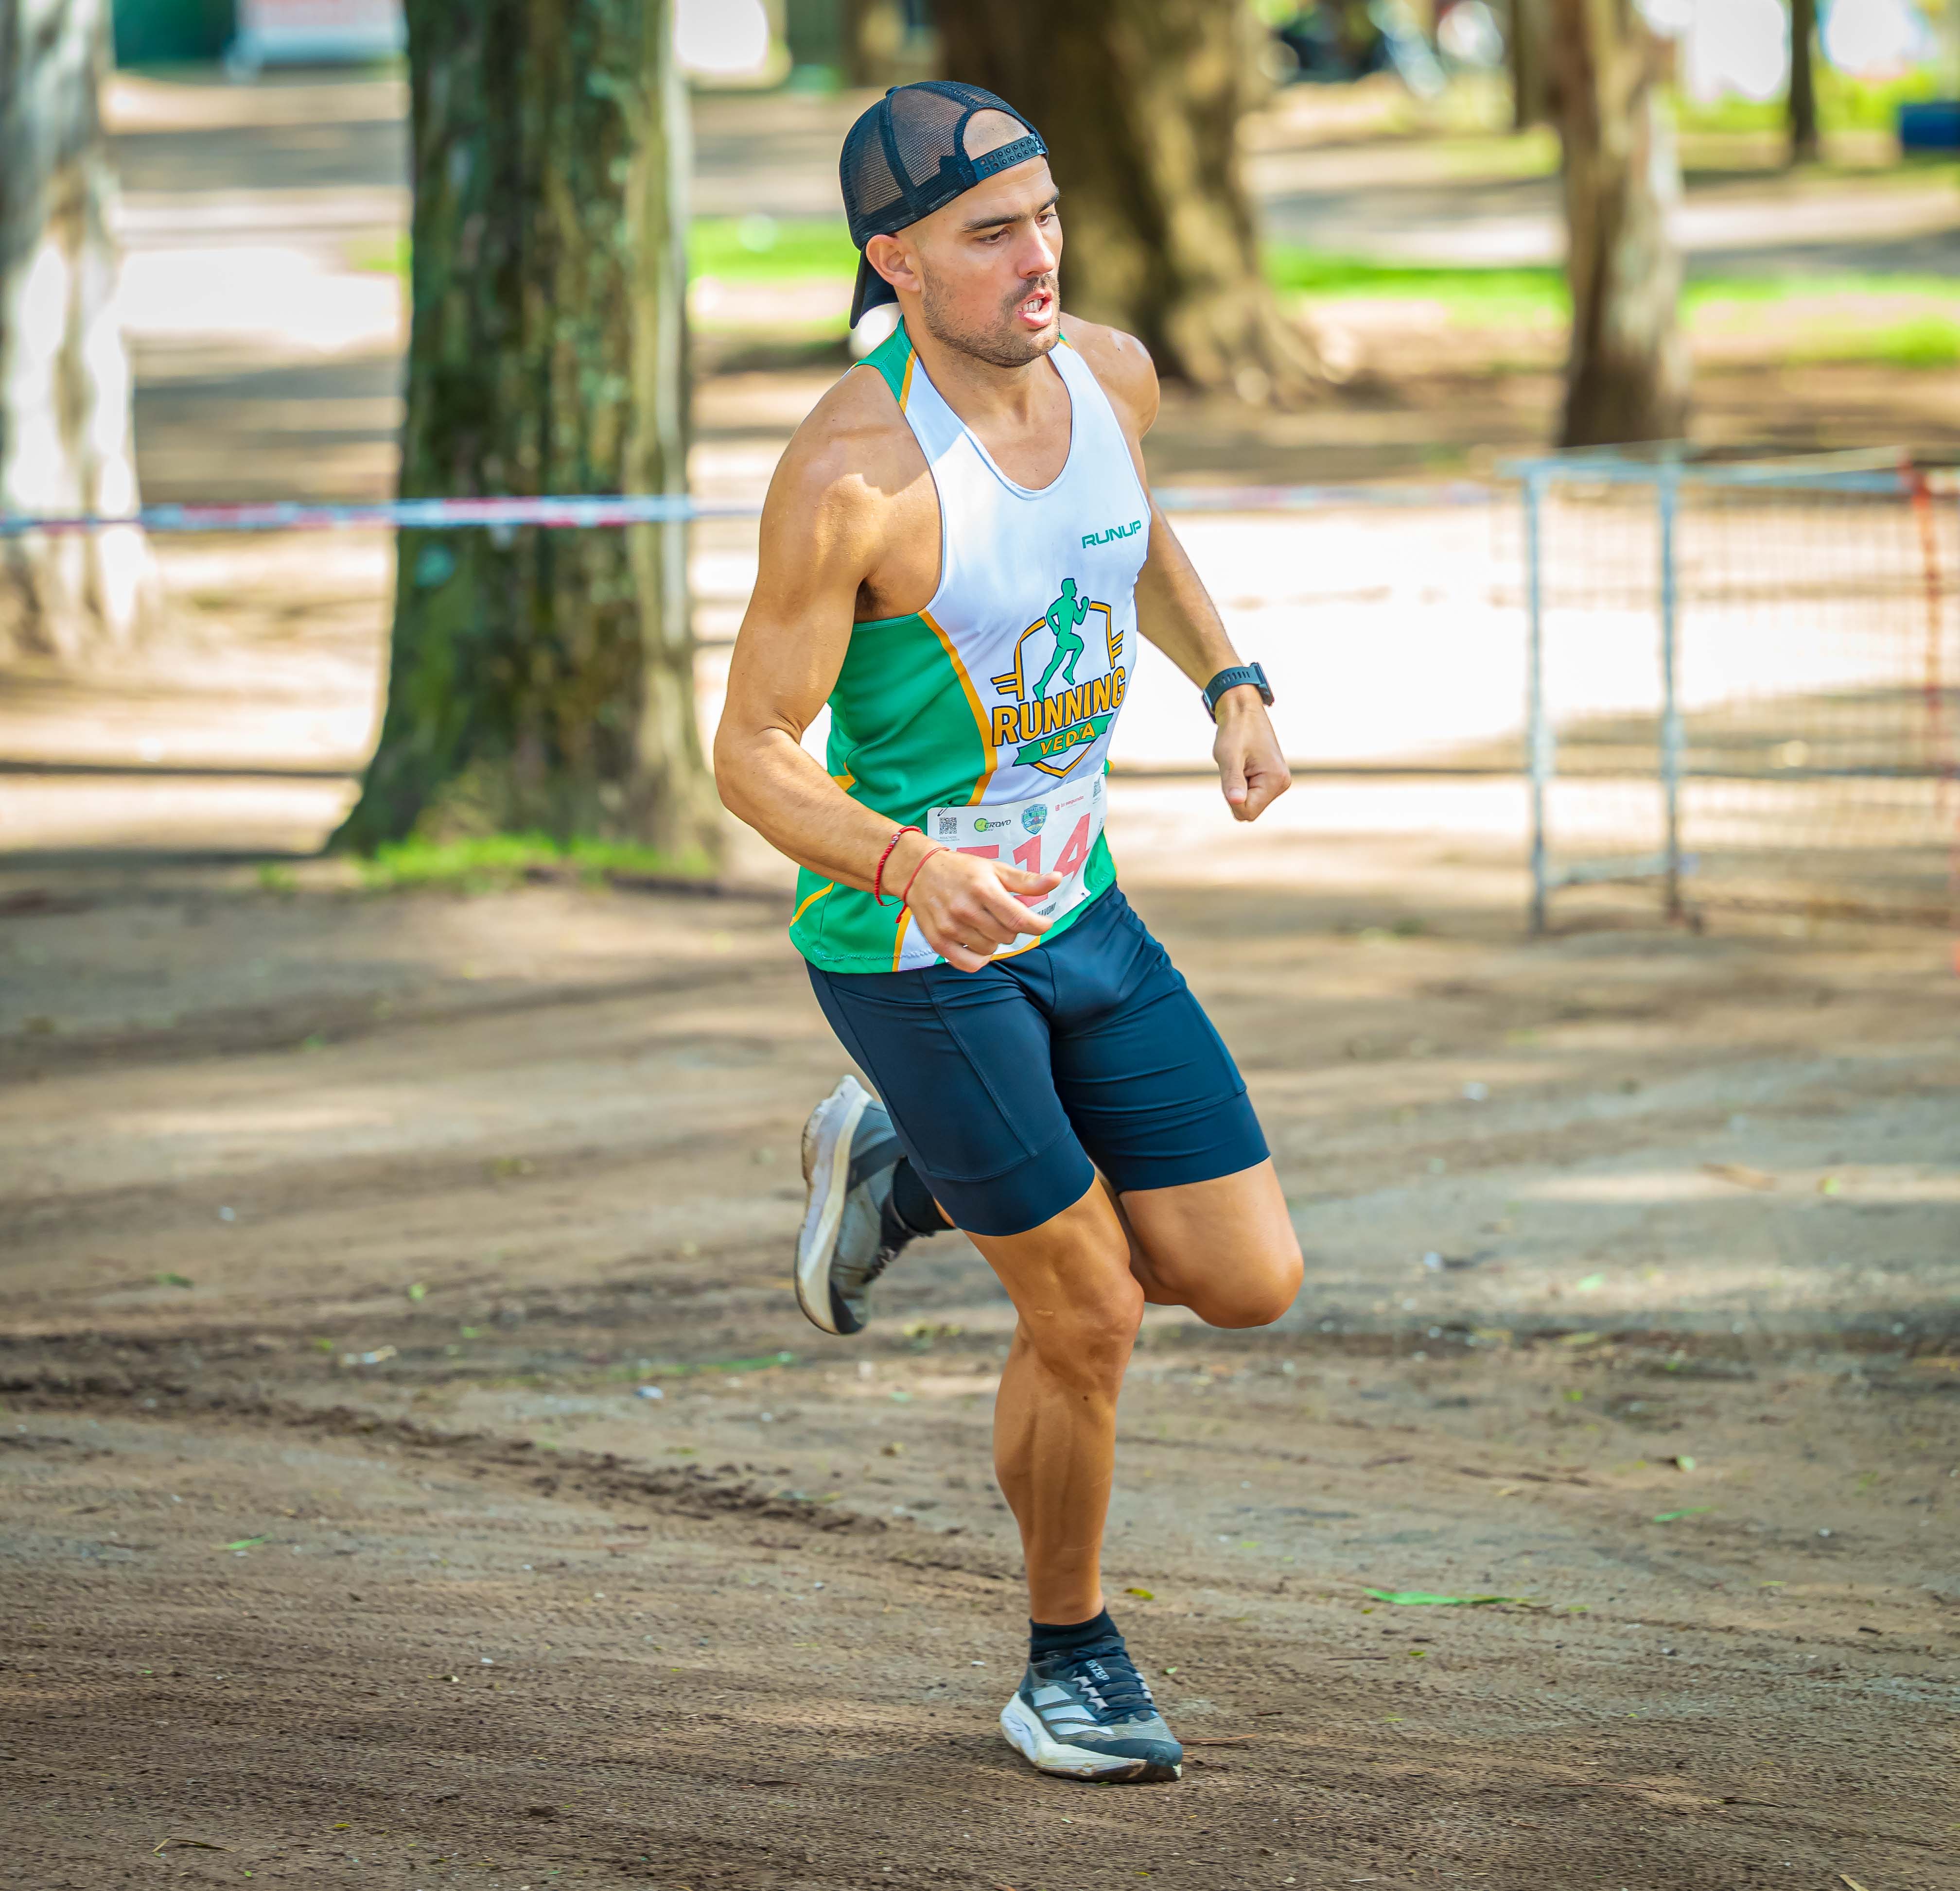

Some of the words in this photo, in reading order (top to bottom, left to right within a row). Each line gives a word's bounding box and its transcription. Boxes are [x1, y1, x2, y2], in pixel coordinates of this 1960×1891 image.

[1082, 520, 1141, 548] RUNUP
[991, 666, 1126, 747] RUNNING
[984, 819, 1011, 828] CRONO
[956, 813, 1090, 908] 14
